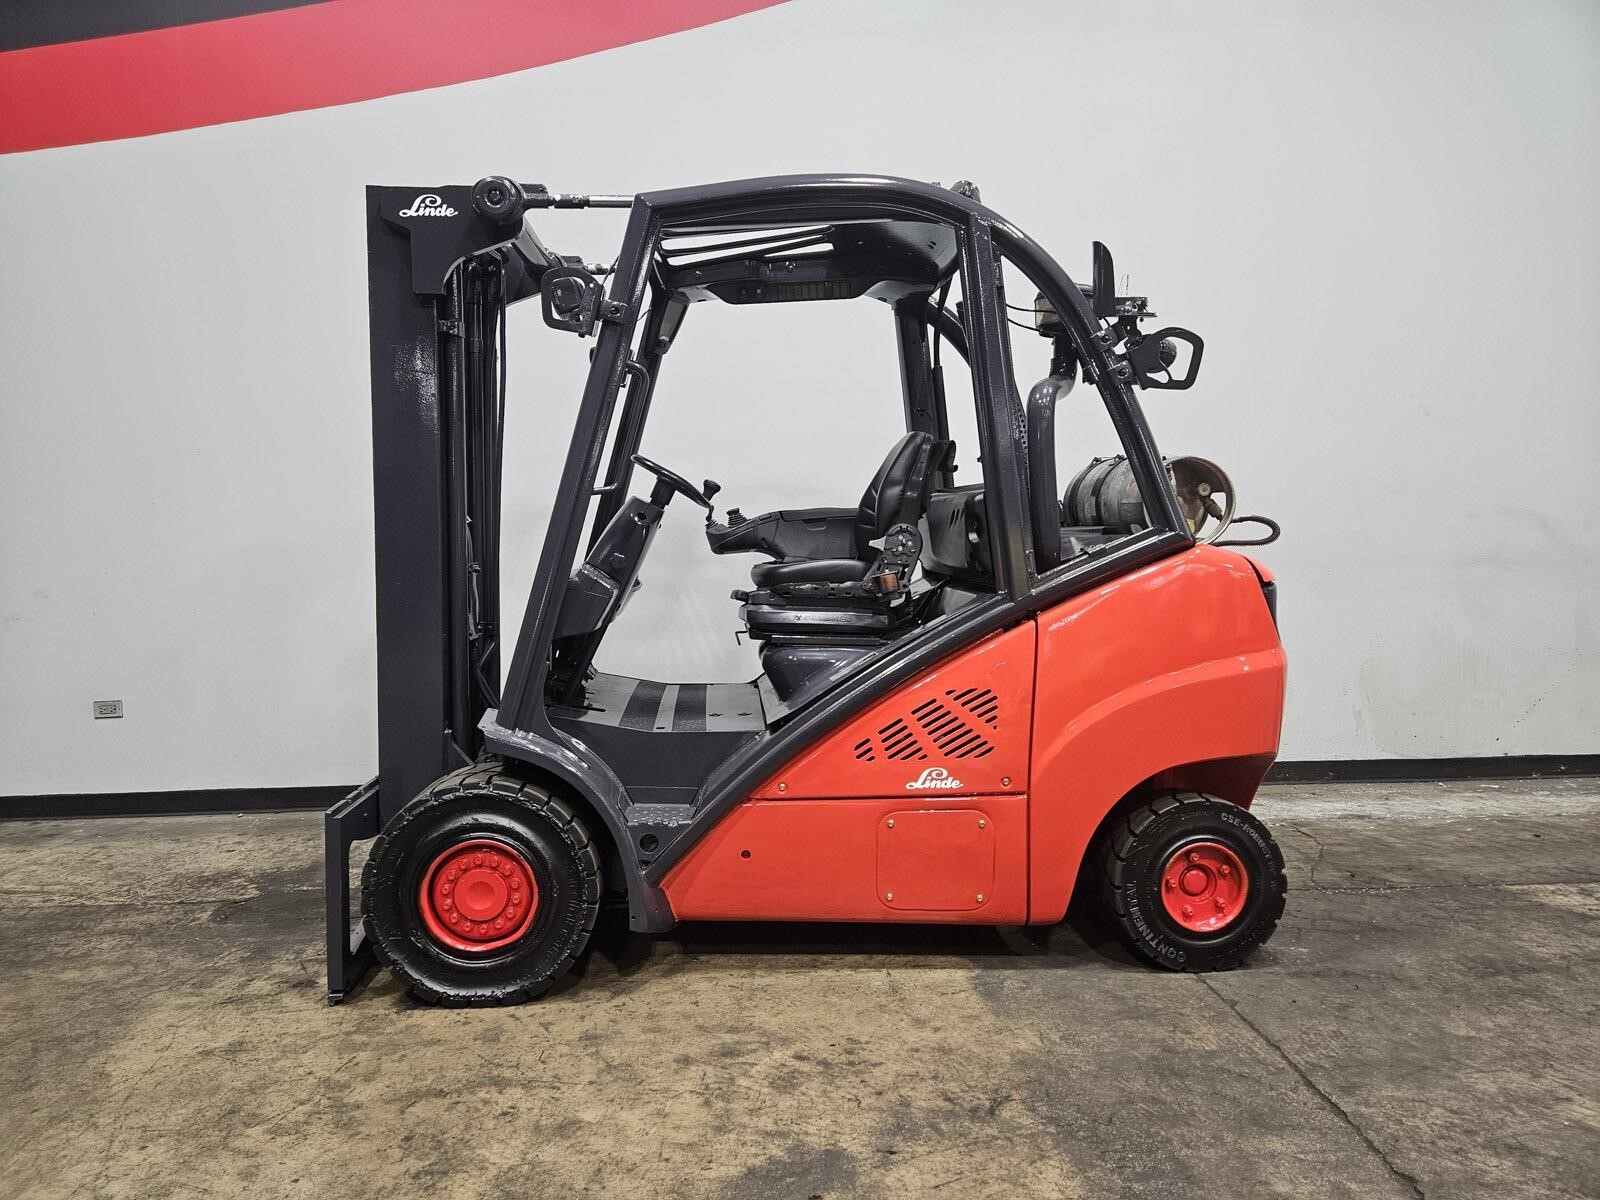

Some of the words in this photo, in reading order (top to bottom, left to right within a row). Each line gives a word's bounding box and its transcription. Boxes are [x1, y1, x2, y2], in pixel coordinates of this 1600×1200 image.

[399, 194, 458, 217] Linde
[905, 767, 964, 789] Linde
[1126, 880, 1185, 962] CONTINENTAL
